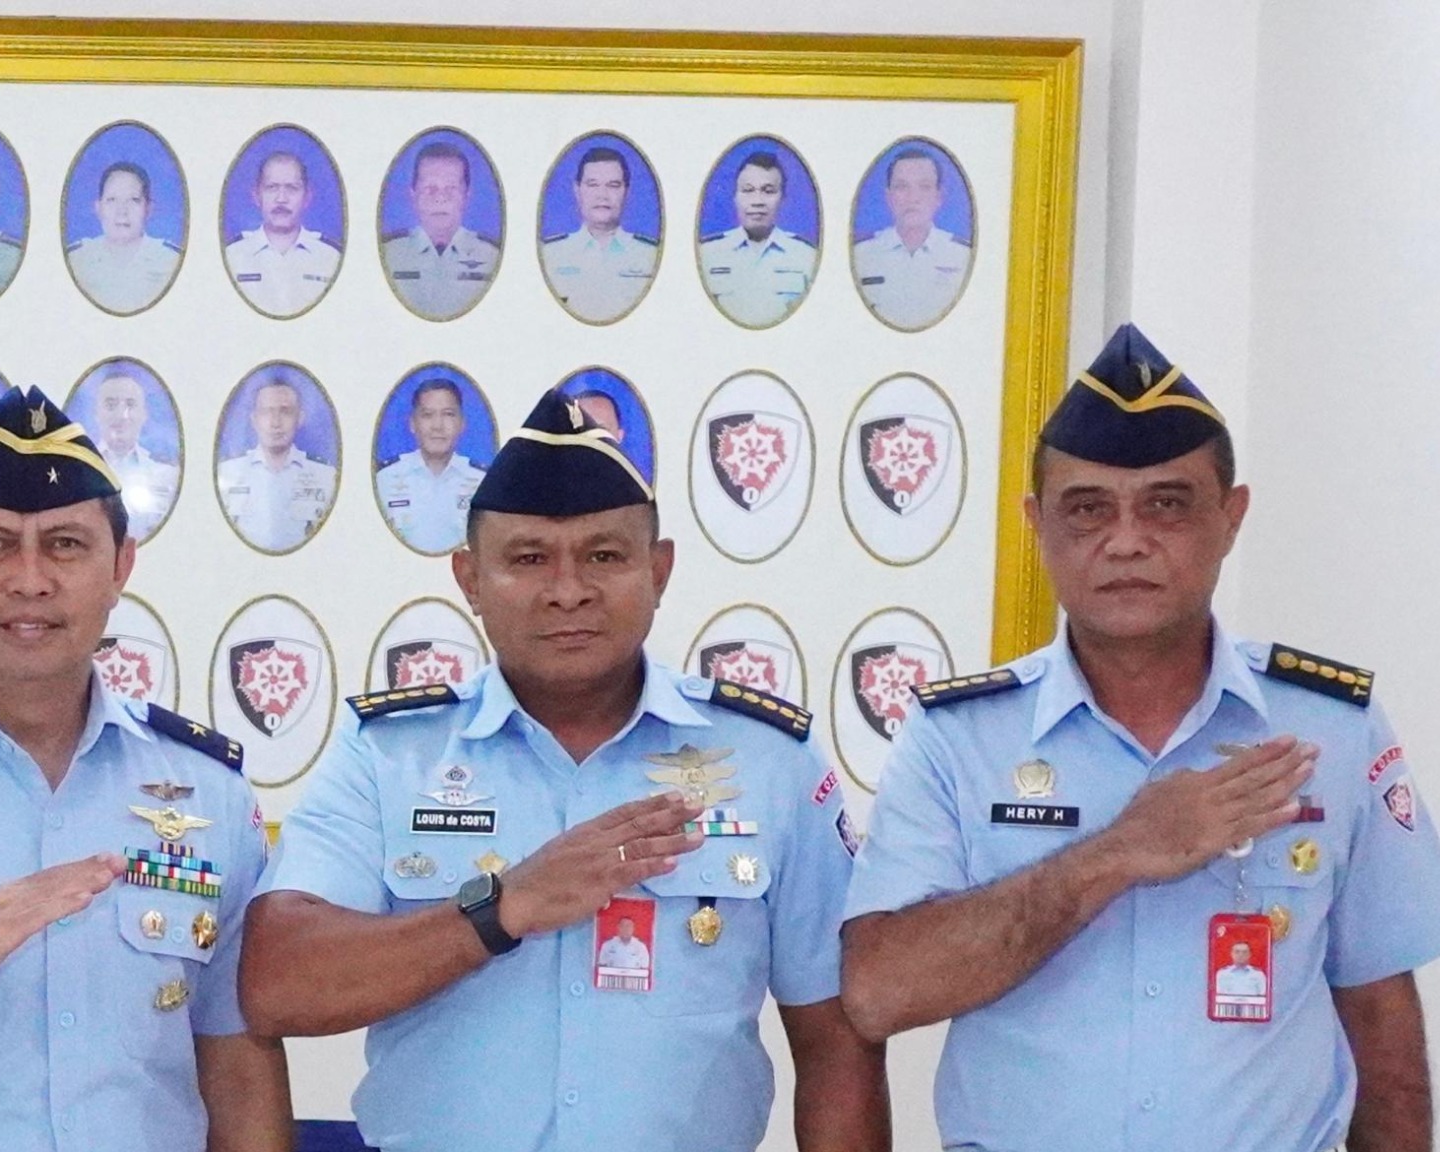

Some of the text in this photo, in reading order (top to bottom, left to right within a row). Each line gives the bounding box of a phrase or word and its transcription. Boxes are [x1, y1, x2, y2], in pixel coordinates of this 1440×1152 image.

[416, 813, 445, 825] LOUIS
[460, 815, 491, 827] COSTA
[1006, 806, 1064, 821] HERY H
